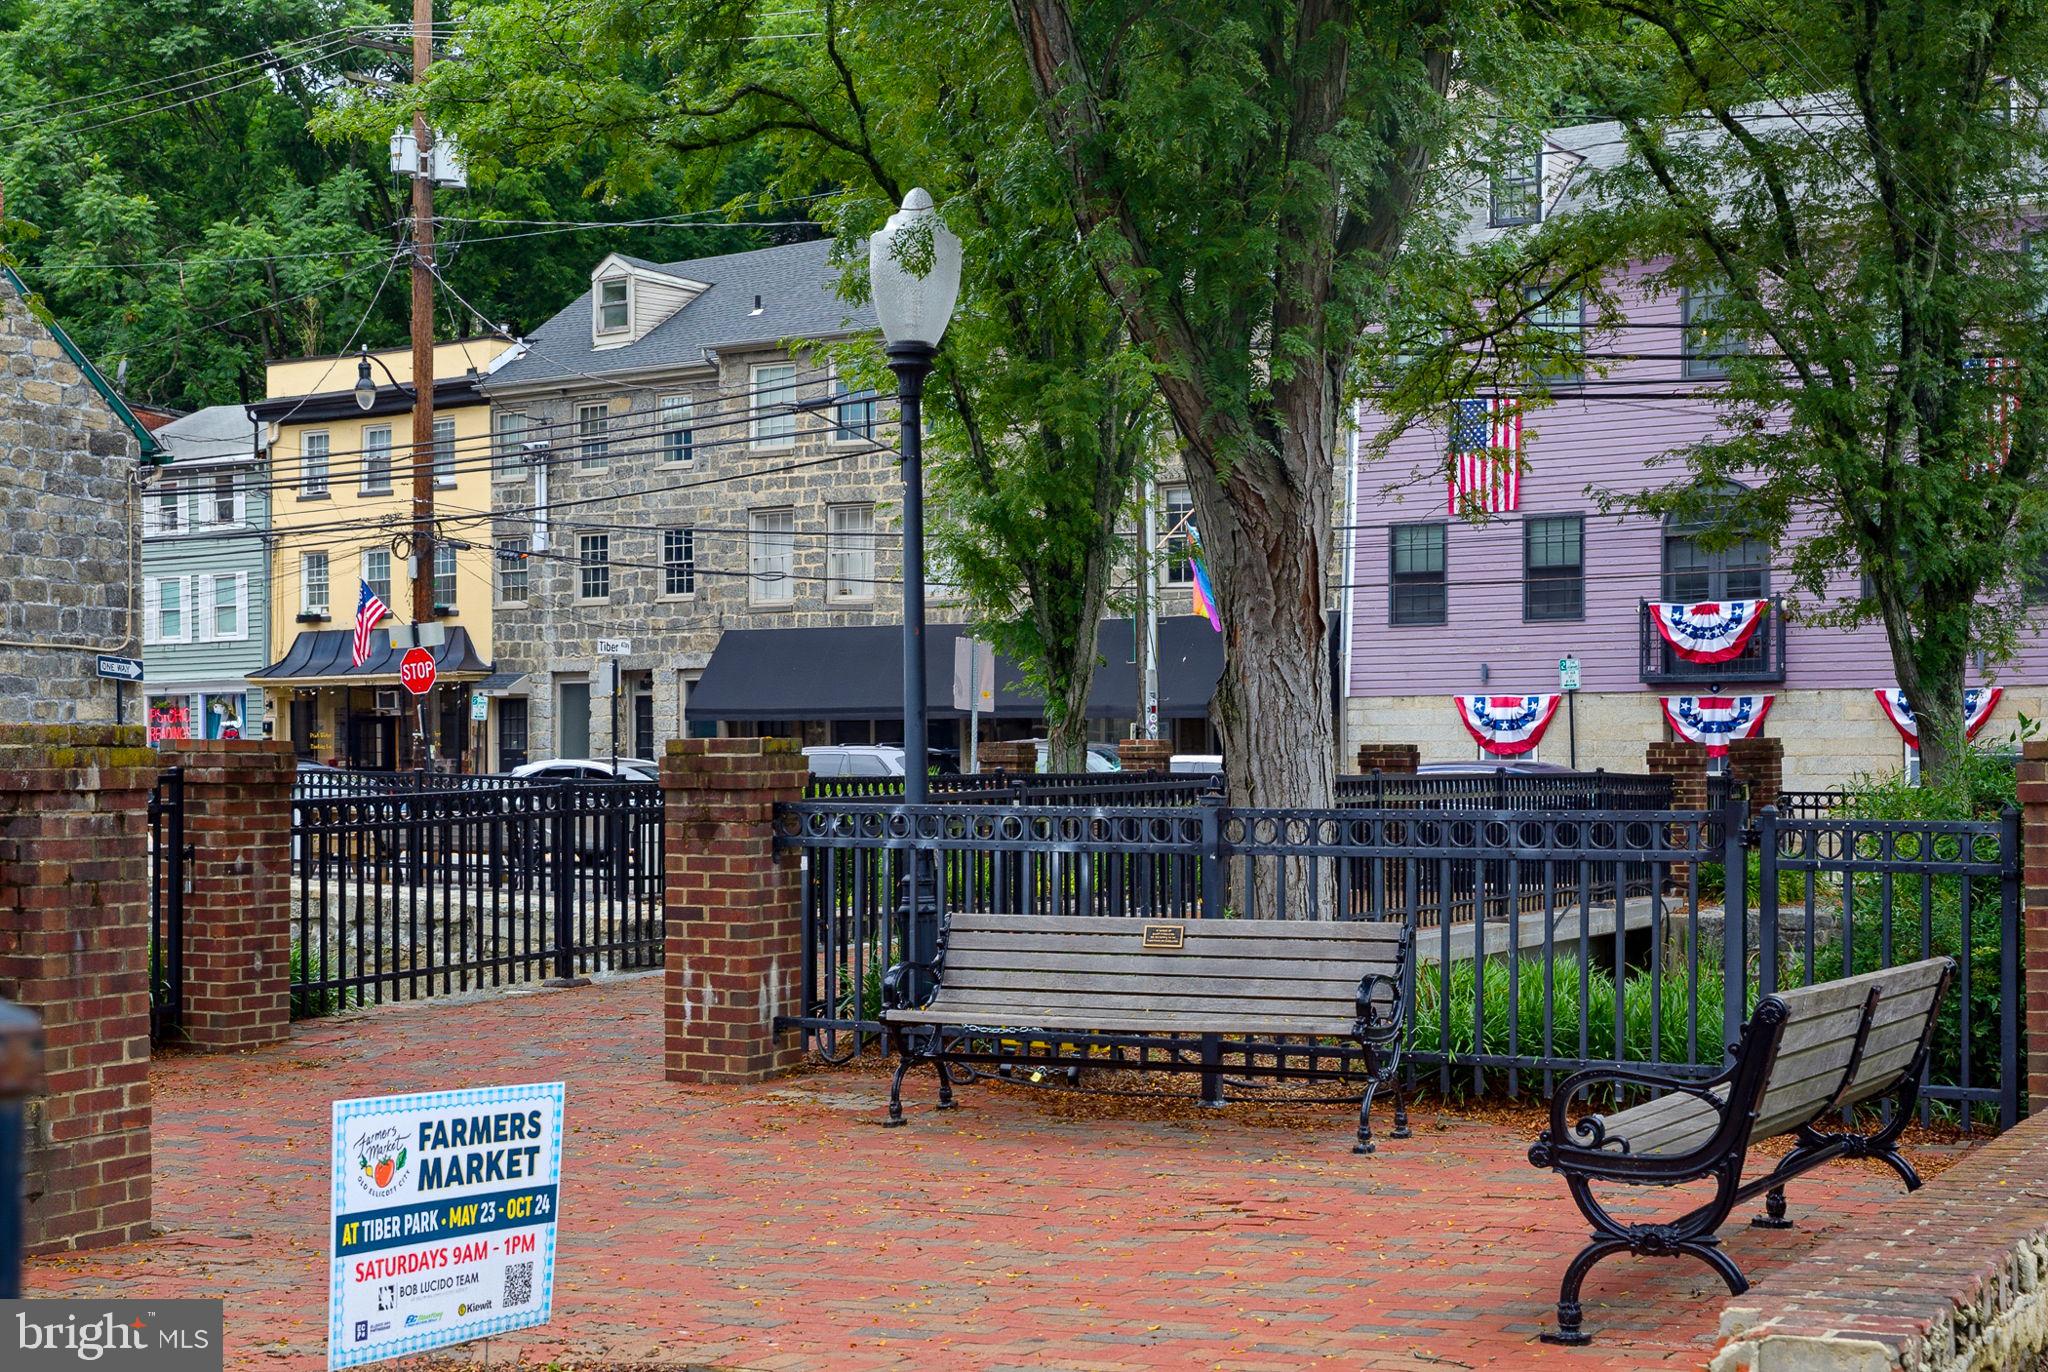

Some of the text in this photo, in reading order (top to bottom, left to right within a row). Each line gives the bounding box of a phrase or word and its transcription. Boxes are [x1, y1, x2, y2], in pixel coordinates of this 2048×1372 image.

[600, 641, 619, 652] Tiber
[101, 660, 131, 674] ONE WAY
[403, 660, 434, 682] STOP
[149, 726, 192, 742] READINGS
[353, 1126, 397, 1159] Farmers
[418, 1110, 542, 1152] FARMERS
[365, 1133, 412, 1160] Market
[357, 1175, 369, 1190] OLD
[398, 1169, 411, 1187] CITY
[417, 1145, 541, 1192] MARKET
[342, 1222, 360, 1247] AT
[361, 1215, 401, 1243] TIBER
[404, 1209, 439, 1236] PARK
[449, 1203, 479, 1229] MAY
[480, 1201, 496, 1224] 23
[506, 1195, 533, 1219] OCT
[534, 1193, 551, 1216] 24
[355, 1247, 448, 1283] SATURDAYS
[452, 1240, 488, 1265] 9AM
[503, 1232, 535, 1256] 1PM
[399, 1284, 418, 1298] BOB
[420, 1276, 454, 1294] LUCIDO
[455, 1272, 480, 1287] TEAM
[466, 1299, 493, 1314] Kiewit
